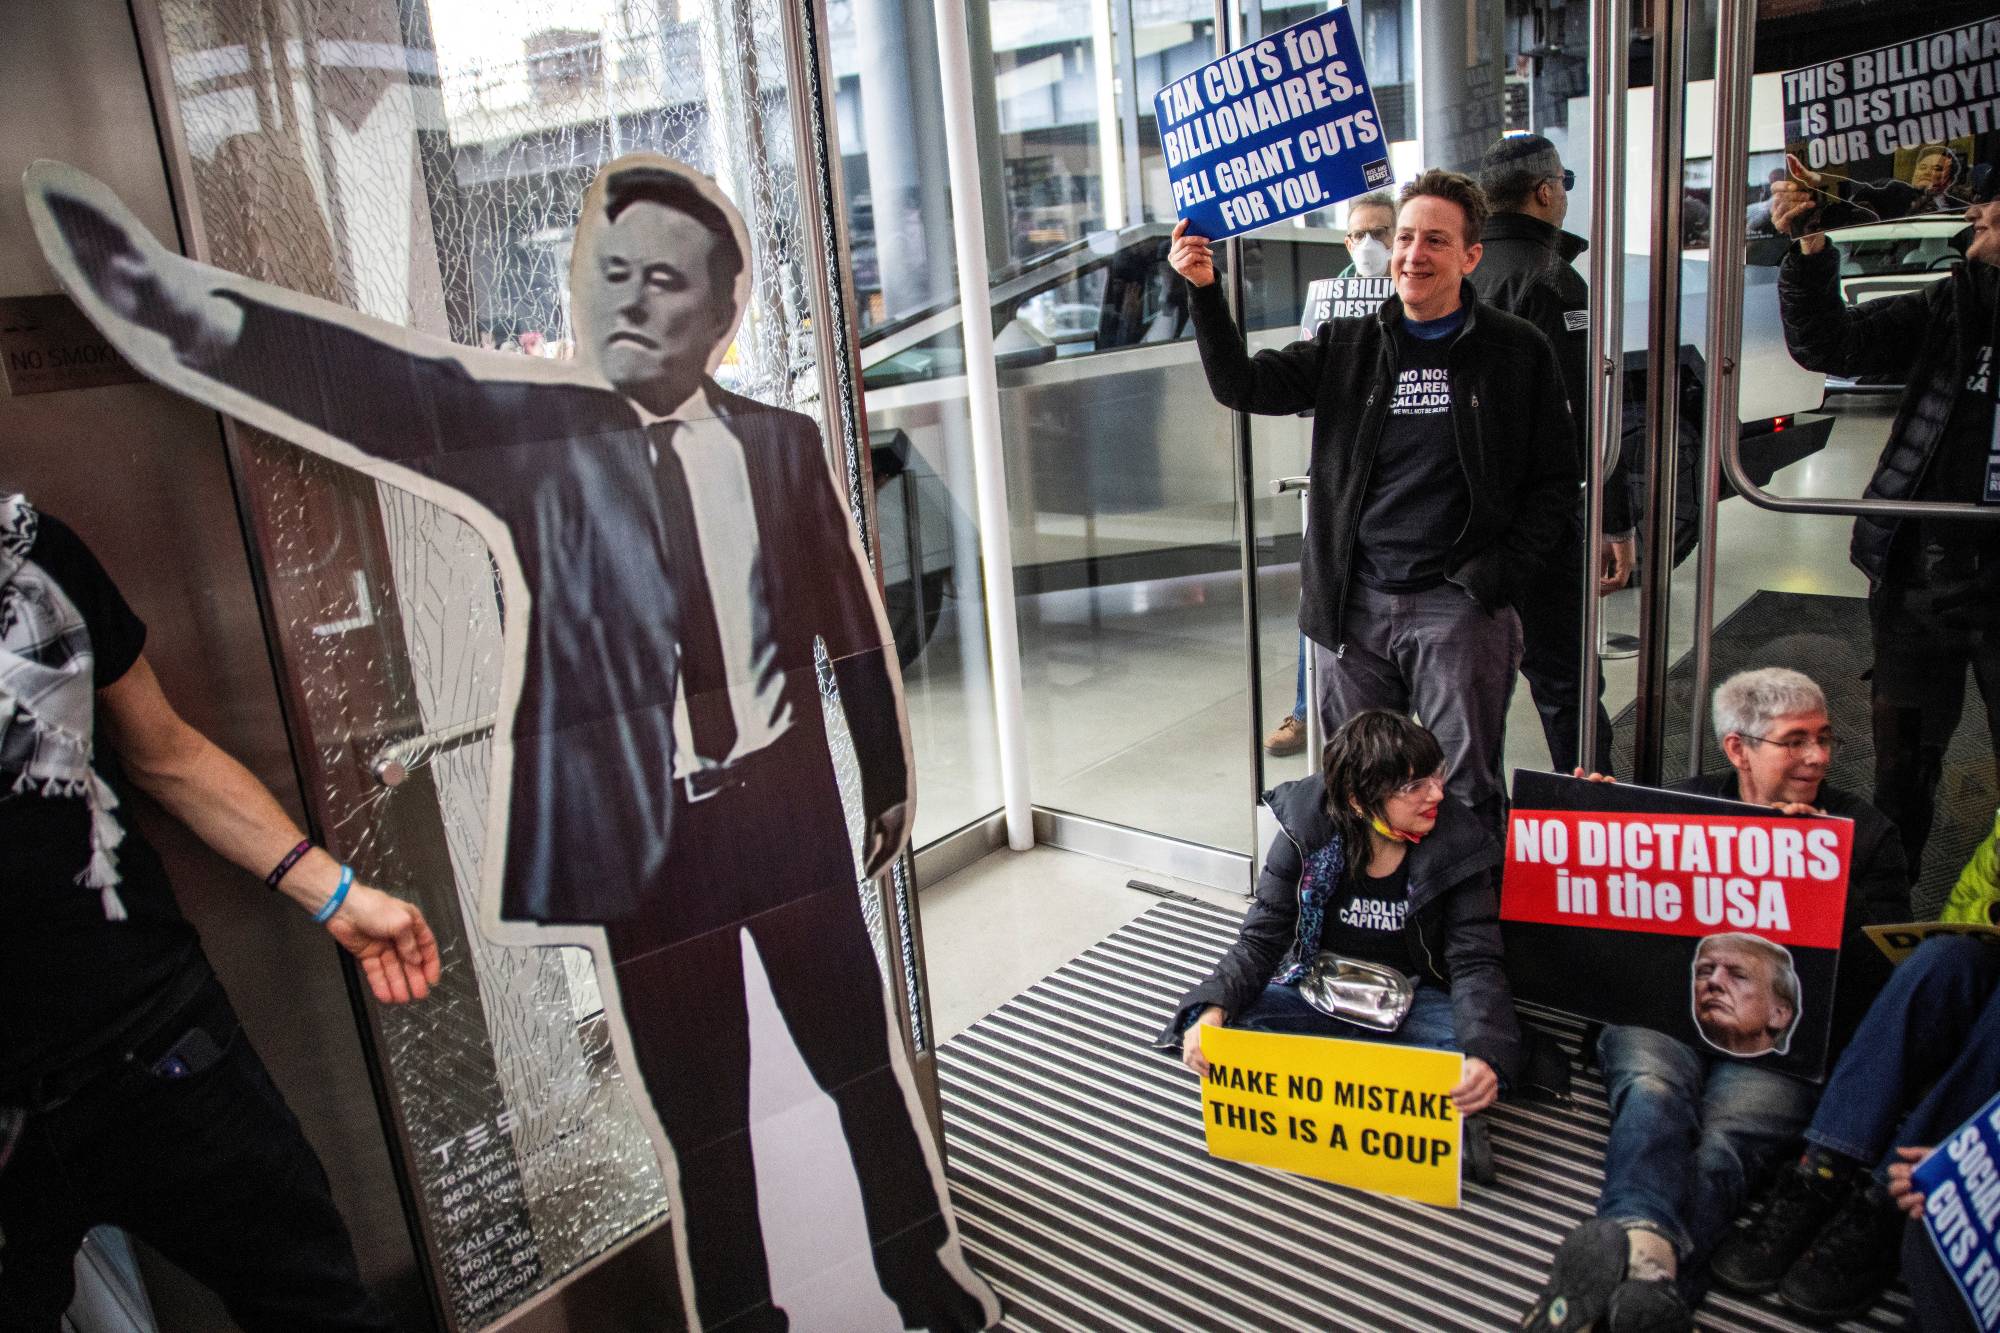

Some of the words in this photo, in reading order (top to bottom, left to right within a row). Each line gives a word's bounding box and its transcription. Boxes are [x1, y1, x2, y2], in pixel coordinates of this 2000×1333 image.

[1161, 75, 1204, 126] TAX
[1204, 40, 1282, 104] CUTS
[1284, 20, 1338, 71] for
[1784, 61, 1847, 106] THIS
[1853, 19, 2000, 90] BILLIONA
[1164, 61, 1364, 169] BILLIONAIRES.
[1801, 102, 1828, 137] IS
[1834, 60, 2000, 130] DESTROYI
[1172, 169, 1217, 212] PELL
[1215, 137, 1296, 194] GRANT
[1299, 109, 1379, 164] CUTS
[1808, 130, 1871, 170] OUR
[1219, 190, 1270, 231] FOR
[1268, 171, 1330, 214] YOU.
[1314, 300, 1331, 320] IS
[10, 349, 42, 371] NO
[1400, 369, 1419, 383] NO
[1389, 394, 1452, 409] CALLADO
[1513, 818, 1568, 865] NO
[1578, 820, 1840, 882] DICTATORS
[1556, 868, 1599, 917] in
[1607, 870, 1682, 923] the
[1693, 876, 1792, 932] USA
[1208, 1062, 1278, 1097] MAKE
[1288, 1074, 1323, 1103] NO
[1334, 1080, 1453, 1122] MISTAKE
[1208, 1099, 1278, 1137] THIS
[1289, 1116, 1318, 1144] IS
[1329, 1123, 1349, 1151] A
[1361, 1128, 1452, 1168] COUP
[447, 1199, 480, 1226] New
[455, 1223, 505, 1258] SALES
[1926, 1179, 1979, 1270] CUTS
[460, 1252, 492, 1277] Mon
[461, 1265, 498, 1297] Wed
